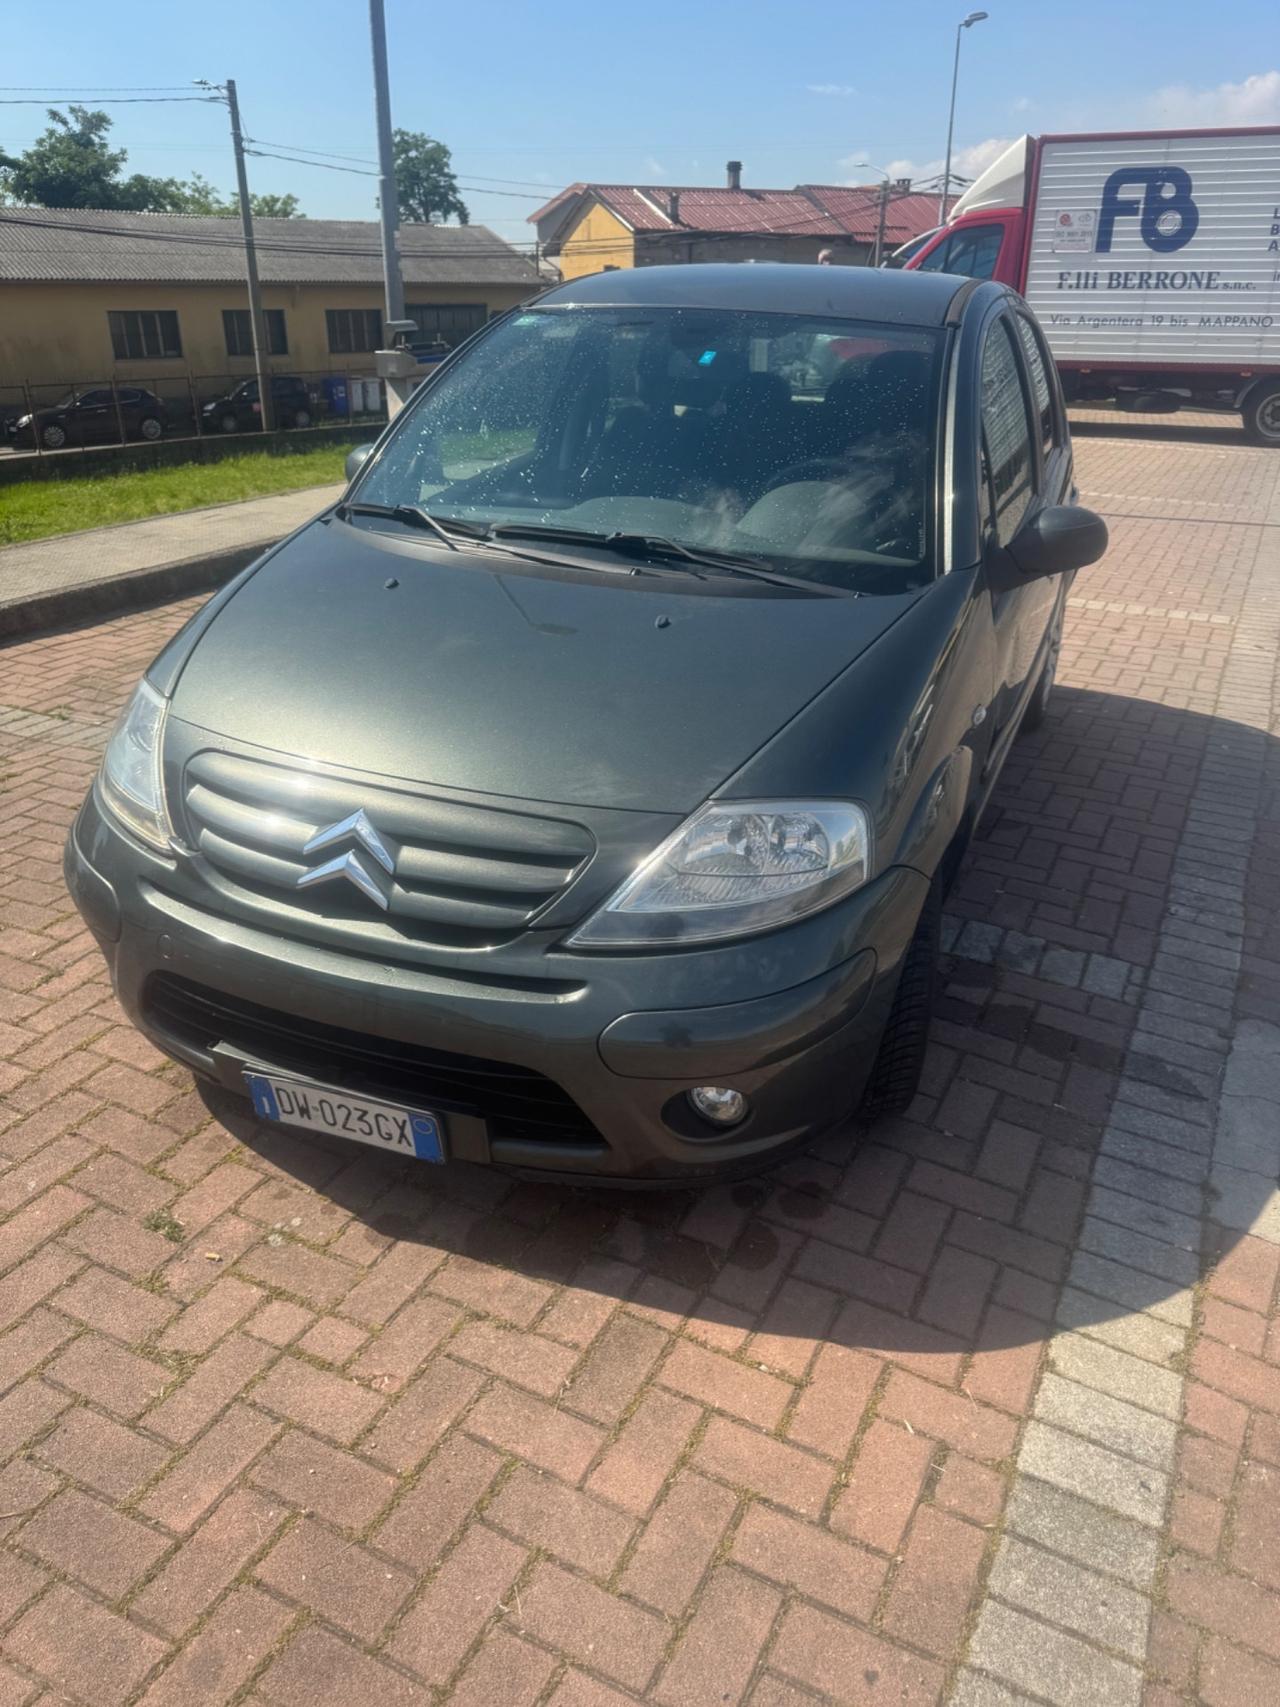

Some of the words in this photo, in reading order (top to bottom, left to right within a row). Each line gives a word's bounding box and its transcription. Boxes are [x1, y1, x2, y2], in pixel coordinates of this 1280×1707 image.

[1056, 271, 1098, 290] F.lli
[1107, 271, 1220, 290] BERRONE
[1050, 314, 1071, 326] Via
[1078, 315, 1143, 328] Argentera
[1152, 315, 1164, 326] 19
[1170, 315, 1189, 327] bis
[1198, 315, 1274, 328] MAPPANO
